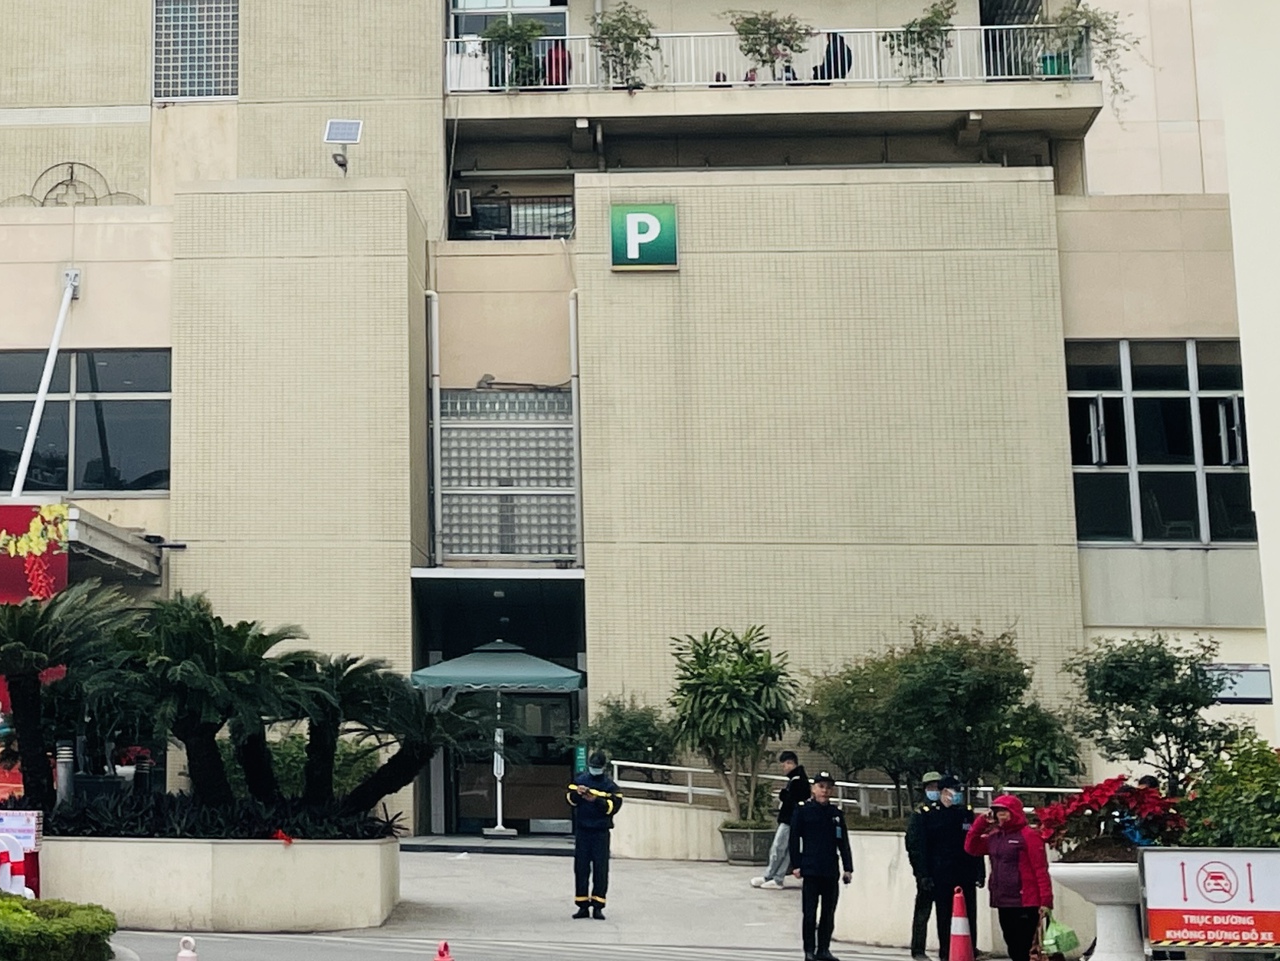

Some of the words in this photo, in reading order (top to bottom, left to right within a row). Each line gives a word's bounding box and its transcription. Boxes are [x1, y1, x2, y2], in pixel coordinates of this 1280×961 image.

[626, 212, 661, 259] P
[1165, 929, 1206, 940] KHÔNG
[1260, 932, 1274, 941] XE
